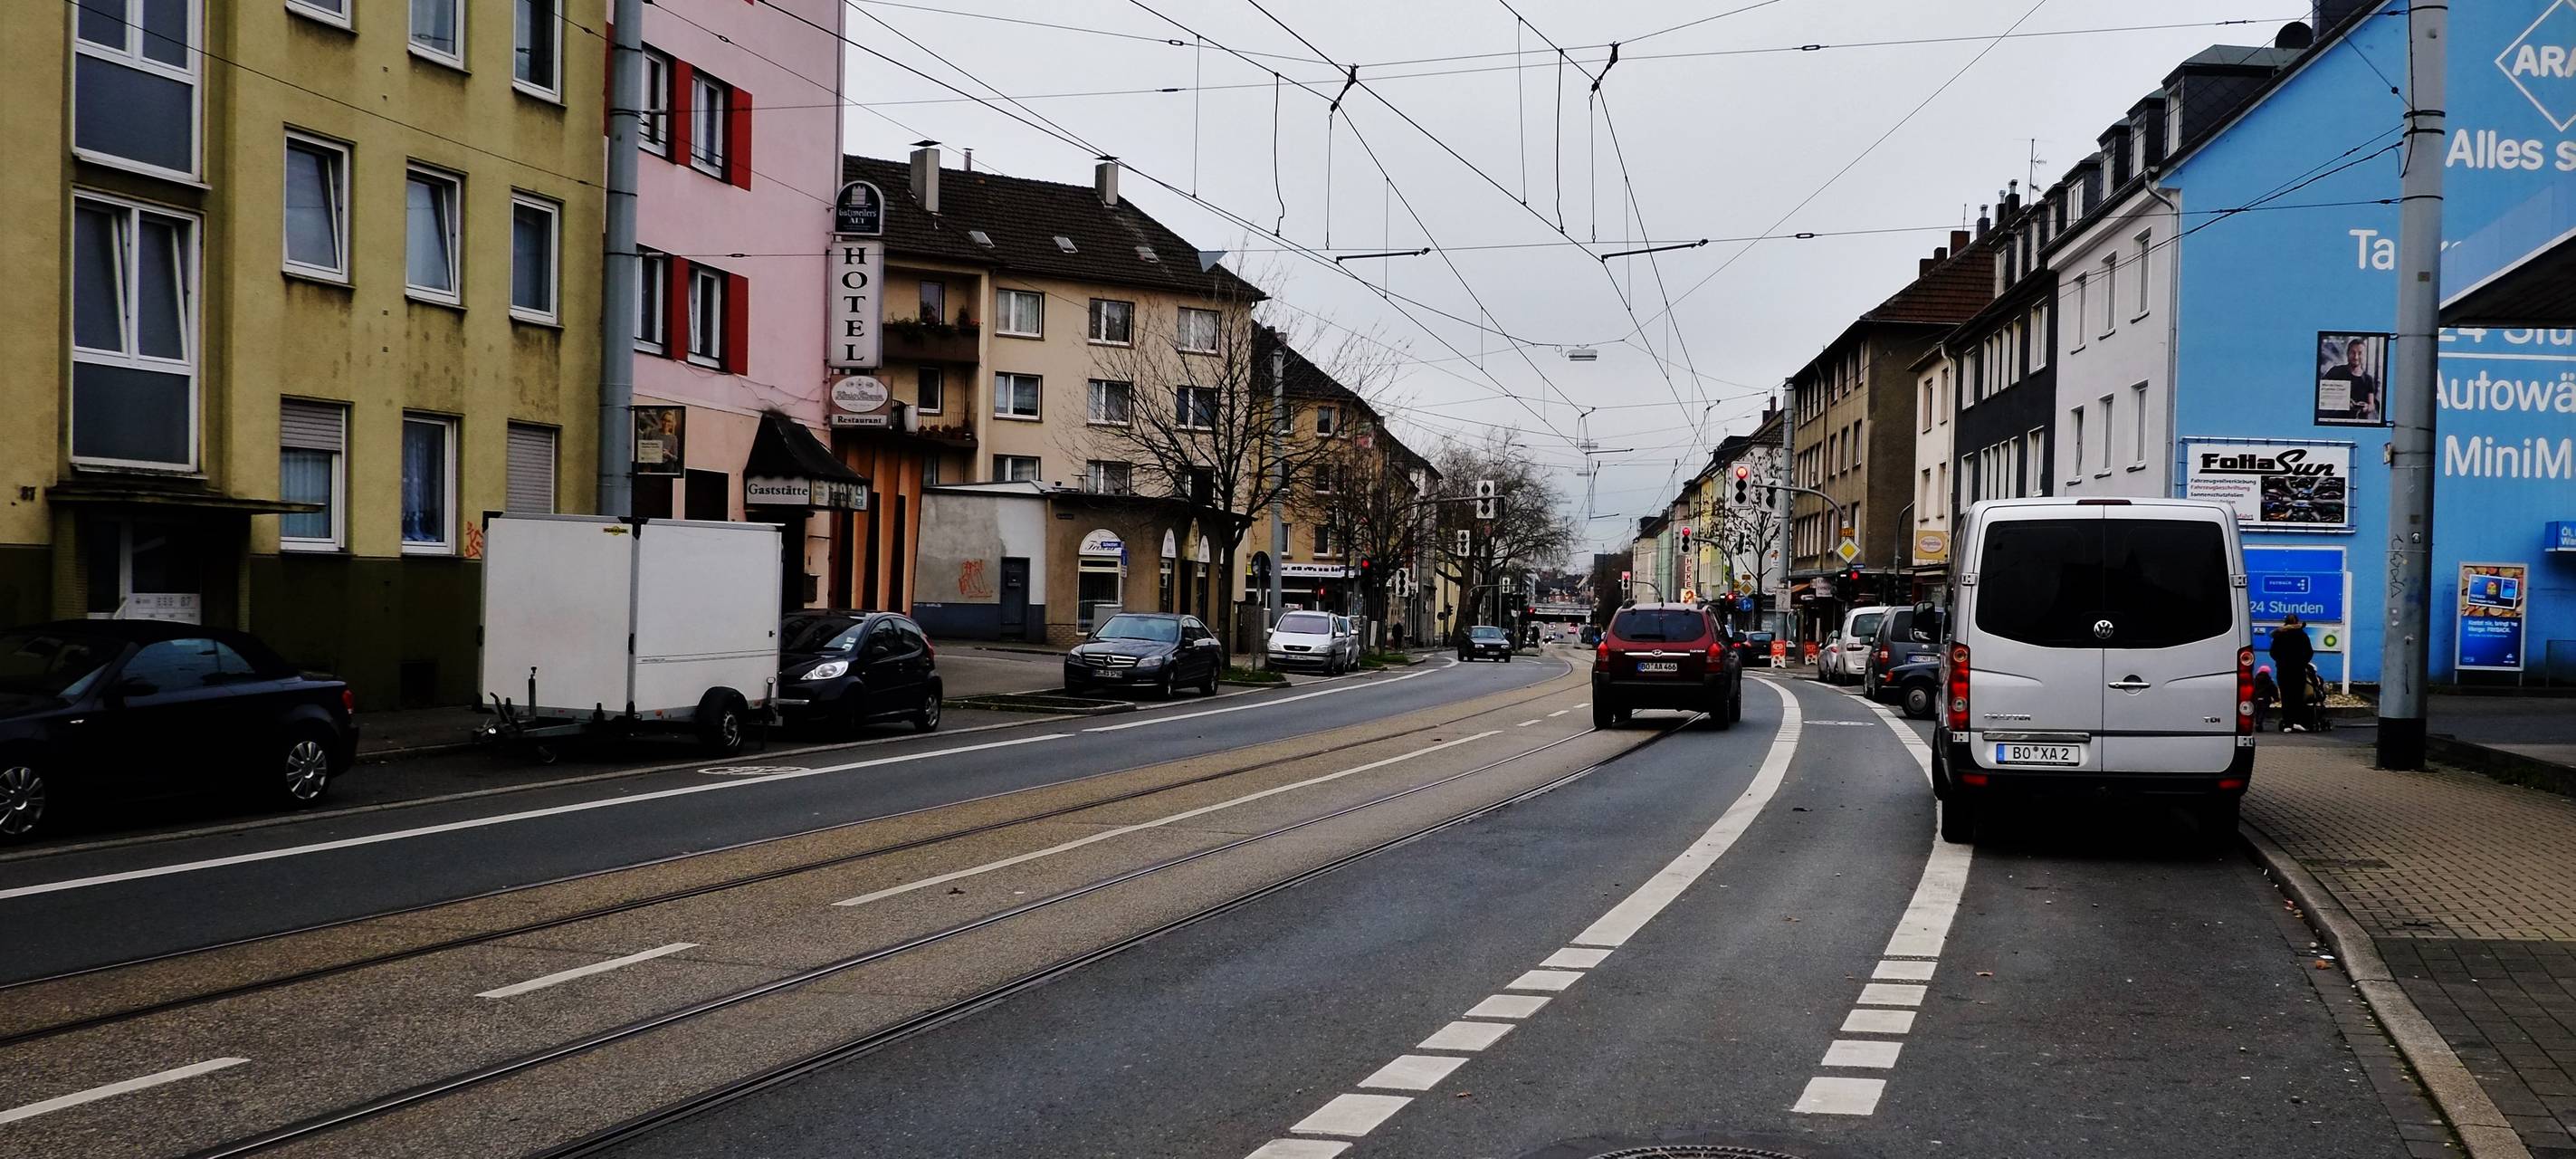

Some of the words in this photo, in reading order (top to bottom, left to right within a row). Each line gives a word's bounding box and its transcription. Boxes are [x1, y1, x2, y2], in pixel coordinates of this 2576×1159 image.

[2446, 129, 2544, 170] Alles
[841, 247, 869, 361] HOTEL
[837, 416, 883, 425] Restaurant
[2445, 435, 2576, 480] MiniM
[748, 483, 808, 496] Gaststätte
[2249, 600, 2265, 613] 24
[2268, 601, 2323, 614] Stunden
[2013, 746, 2031, 760] BO
[2039, 747, 2058, 761] XA
[2061, 748, 2070, 761] 2
